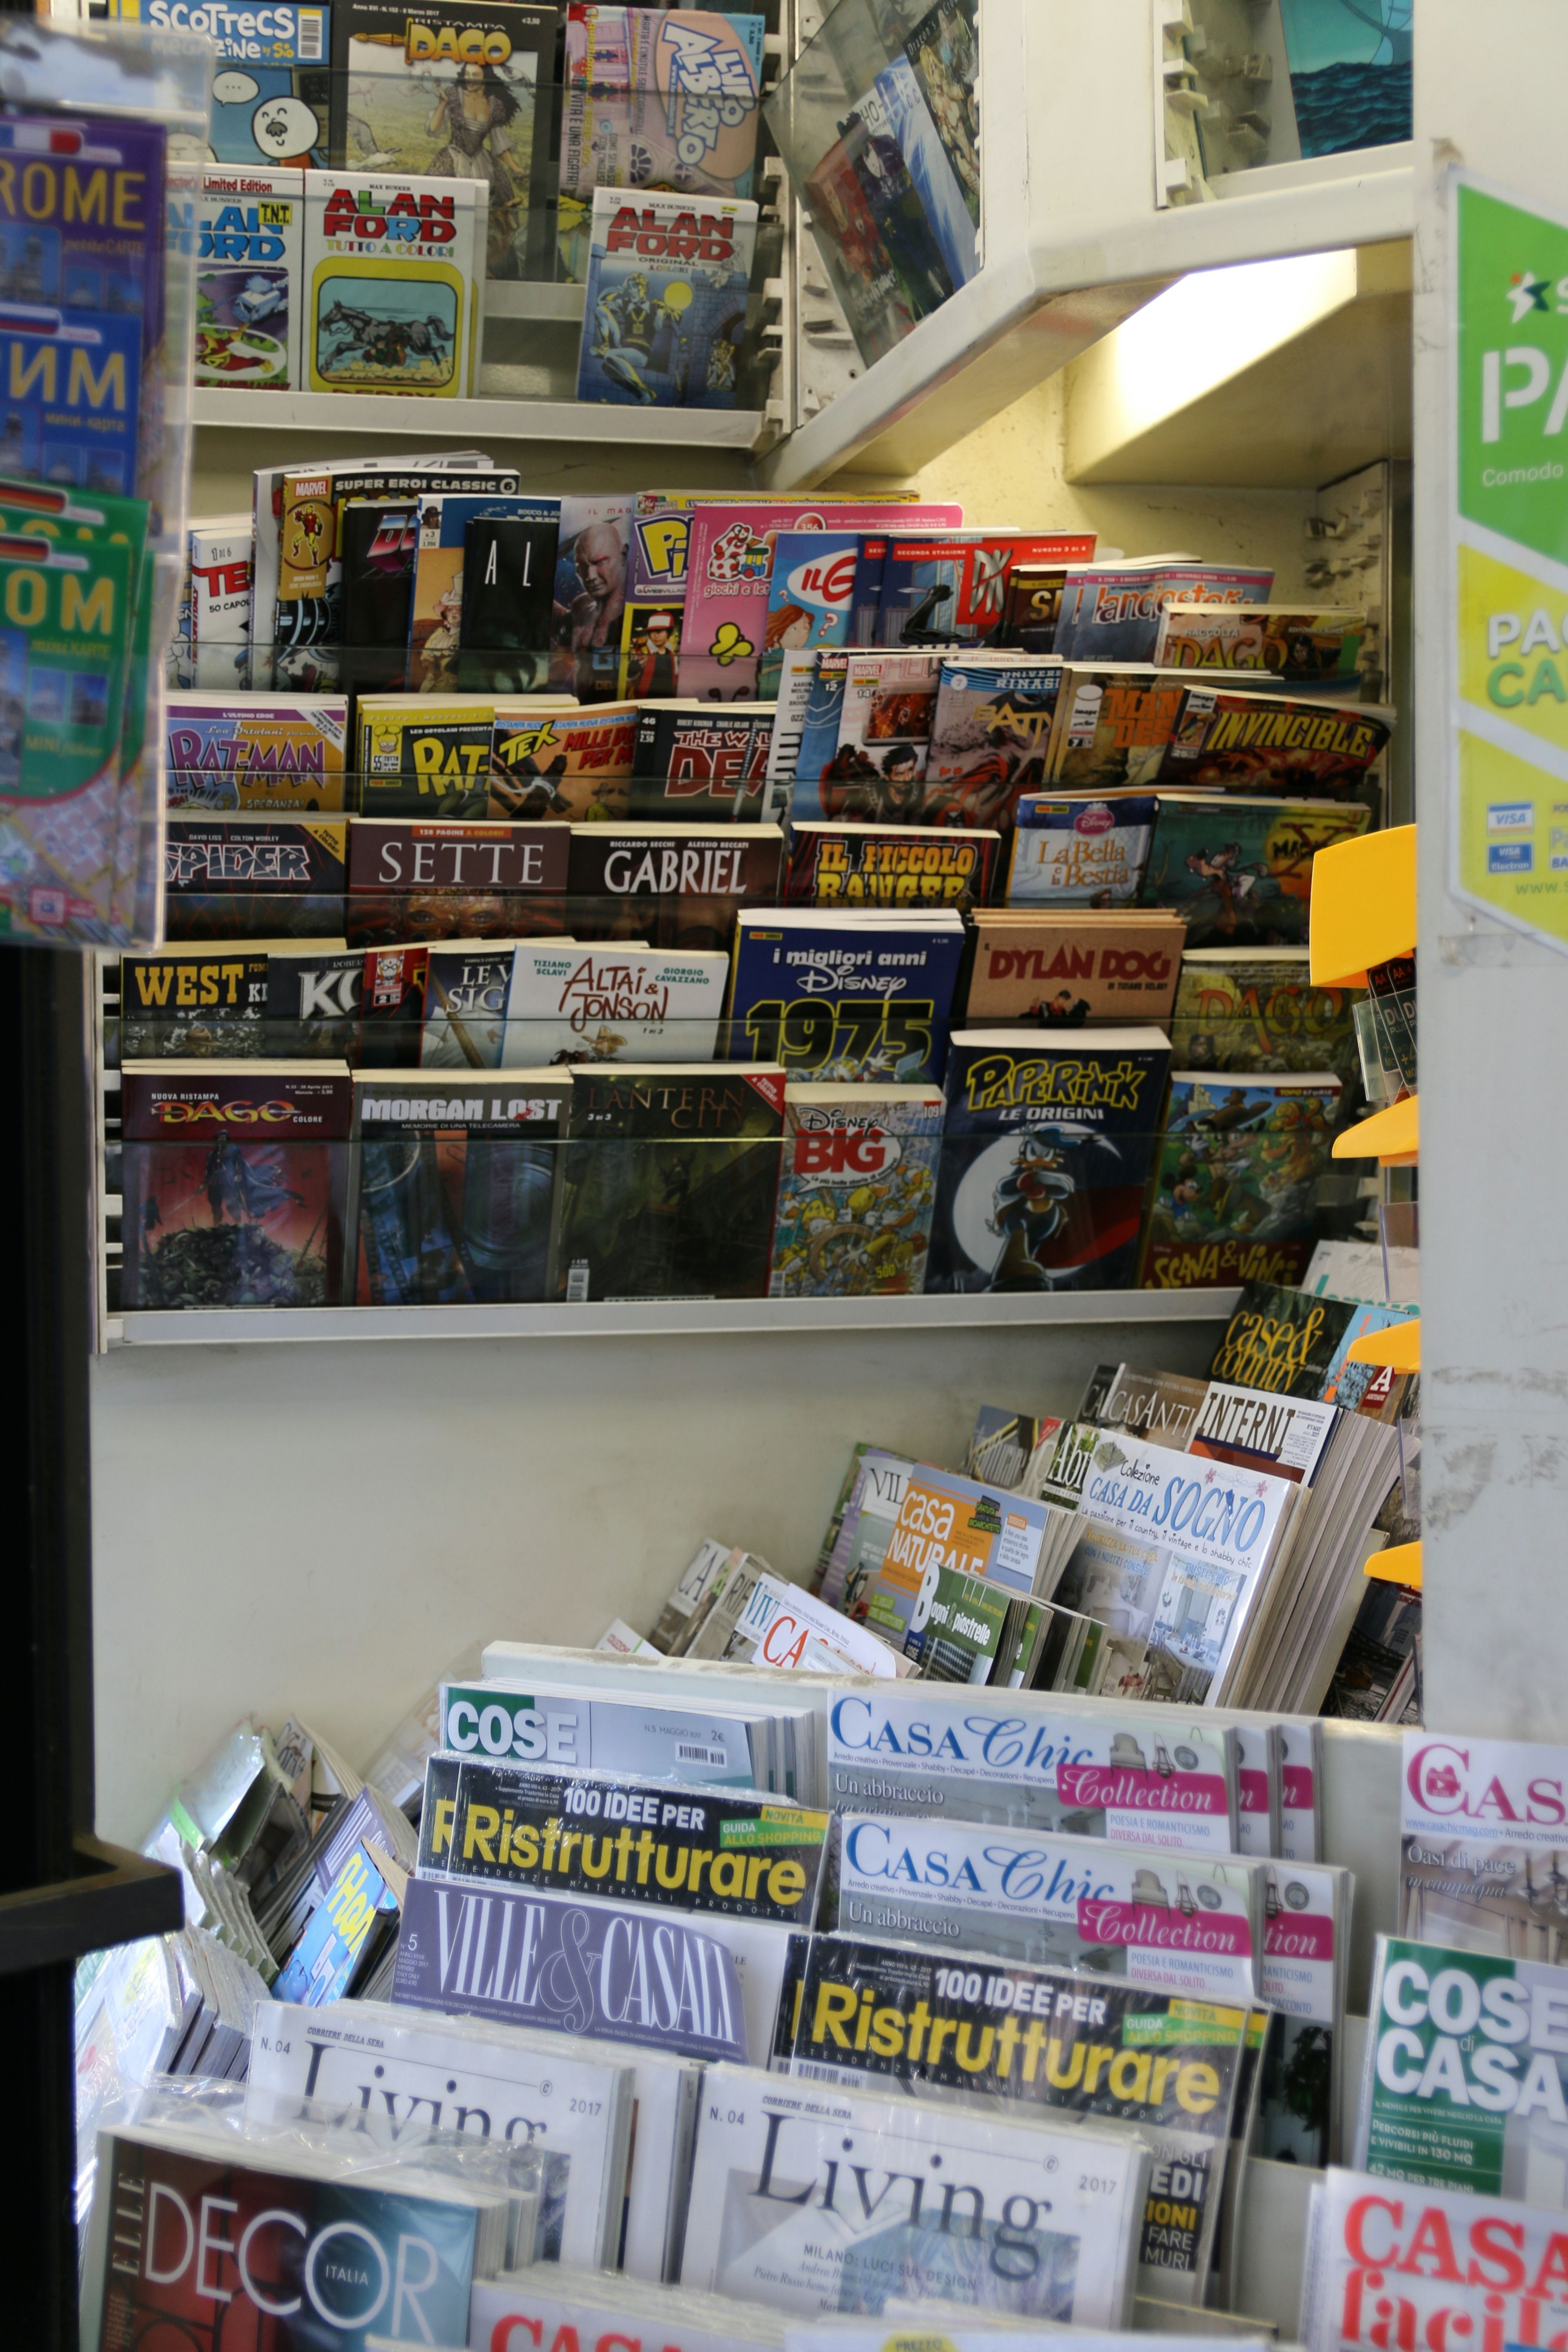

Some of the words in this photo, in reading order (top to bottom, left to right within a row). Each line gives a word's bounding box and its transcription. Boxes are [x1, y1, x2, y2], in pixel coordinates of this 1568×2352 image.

[409, 23, 511, 64] DAGO
[202, 177, 238, 192] Limited
[240, 179, 272, 193] Edition
[324, 189, 454, 218] ALAN
[323, 214, 456, 242] FORD
[609, 207, 733, 238] ALAN
[326, 239, 375, 253] TUTTO
[380, 243, 392, 254] A
[396, 244, 453, 257] COLORI
[607, 230, 733, 261] FORD
[639, 257, 698, 266] ORIGINAL
[295, 481, 327, 497] MARVEL
[336, 479, 384, 491] SUPER
[389, 480, 426, 489] EROI
[432, 480, 496, 491] CLASSIC
[1483, 462, 1563, 487] Comodo
[1185, 628, 1239, 638] RACCOLTA
[821, 658, 848, 669] MARVEL
[853, 664, 881, 676] MARVEL
[499, 720, 560, 767] TEX
[1204, 711, 1375, 759] INVINCIBLE
[170, 729, 325, 788] RAT-MAN
[1495, 812, 1527, 825] VISA
[378, 841, 543, 884] SETTE
[818, 841, 851, 873] IL
[863, 842, 977, 874] PICCOLO
[1039, 840, 1069, 864] La
[1072, 842, 1125, 863] Bella
[1491, 860, 1530, 871] Electron
[1498, 846, 1521, 856] VISA
[604, 850, 747, 894] GABRIEL
[1064, 863, 1128, 886] Bestia
[534, 959, 571, 968] TIZIANO
[663, 967, 704, 977] GIORGIO
[774, 948, 780, 964] i
[787, 949, 873, 967] migliori
[878, 951, 927, 965] anni
[989, 941, 1096, 980] DYLAN
[1099, 949, 1173, 980] DOG
[135, 963, 243, 1007] WEST
[536, 968, 567, 977] SCLAVI
[655, 975, 709, 984] CAVAZZANO
[745, 998, 934, 1071] 1975
[1194, 986, 1344, 1054] DAGO
[159, 1101, 295, 1124] DAGO
[361, 1099, 487, 1121] MORGAN
[491, 1099, 563, 1120] LOST
[588, 1088, 746, 1110] LANTERN
[924, 1105, 940, 1118] 109
[671, 1106, 745, 1129] CITY
[999, 1109, 1022, 1120] LE
[1026, 1108, 1104, 1120] ORIGINI
[794, 1129, 886, 1174] BIG
[1195, 1392, 1295, 1454] INTERNI
[899, 1490, 955, 1541] casa
[1090, 1476, 1124, 1508] CASA
[1127, 1489, 1153, 1516] DA
[1152, 1476, 1265, 1552] SOGNO
[447, 1700, 578, 1765] COSE
[659, 1726, 688, 1737] MAGGIO
[690, 1730, 702, 1739] 2017
[711, 1730, 726, 1743] 2€
[964, 1716, 1094, 1770] Chic
[834, 1752, 854, 1761] Arredo
[855, 1754, 878, 1764] creativo
[882, 1758, 917, 1769] Provenzale
[921, 1762, 946, 1773] Shabby
[950, 1765, 975, 1776] Decapé
[980, 1768, 1019, 1780] Decorazioni
[1023, 1773, 1054, 1785] Recupero
[834, 1773, 859, 1794] Un
[864, 1782, 945, 1804] abbraccio
[1065, 1770, 1213, 1810] Collection
[564, 1787, 601, 1815] 100
[604, 1792, 660, 1824] IDEE
[662, 1807, 706, 1831] PER
[765, 1809, 804, 1824] NOVITÀ
[722, 1822, 756, 1834] GUIDA
[725, 1833, 755, 1845] ALLO
[757, 1830, 824, 1846] SHOPPING
[1110, 1814, 1139, 1828] POESIA
[1141, 1818, 1145, 1828] E
[1146, 1819, 1210, 1837] ROMANTICISMO
[1405, 1819, 1498, 1838] www.casachicmag.com
[1505, 1828, 1534, 1840] Arredo
[462, 1804, 807, 1906] Ristrutturare
[1408, 1844, 1445, 1868] Oasi
[1452, 1849, 1467, 1869] di
[1473, 1854, 1516, 1876] pace
[1408, 1873, 1422, 1887] in
[1424, 1877, 1505, 1902] campagna
[848, 1902, 873, 1924] Un
[877, 1909, 960, 1936] abbraccio
[1086, 1904, 1236, 1952] Collection
[434, 1889, 546, 2008] VILLE
[539, 1908, 602, 2034] &
[600, 1917, 734, 2045] CASALI
[935, 1967, 985, 2004] 100
[987, 1977, 1053, 2012] IDEE
[1056, 1995, 1107, 2026] PER
[1383, 1960, 1568, 2053] COSE
[260, 2037, 272, 2051] N.
[275, 2040, 291, 2055] 04
[306, 2026, 342, 2040] CORRIERE
[344, 2032, 365, 2045] DELLA
[367, 2037, 385, 2049] SERA
[813, 1981, 1222, 2115] Ristrutturare
[1377, 2028, 1568, 2125] CASA
[291, 2040, 548, 2148] Living
[569, 2098, 602, 2118] 2017
[1372, 2119, 1419, 2139] PERCORSI
[1423, 2130, 1439, 2143] PIÙ
[1442, 2136, 1473, 2150] FLUIDI
[1371, 2136, 1376, 2145] E
[1379, 2137, 1415, 2153] VIVIBILI
[1418, 2146, 1428, 2156] IN
[1431, 2147, 1451, 2159] 130
[1454, 2152, 1473, 2165] MQ
[748, 2110, 1054, 2282] Living
[1079, 2174, 1118, 2196] 2017
[112, 2172, 144, 2276] ELLE
[1148, 2225, 1194, 2252] FARE
[145, 2180, 439, 2345] DECOR
[1145, 2246, 1190, 2270] MURI
[1344, 2194, 1568, 2303] CASA
[324, 2263, 368, 2287] ITALIA
